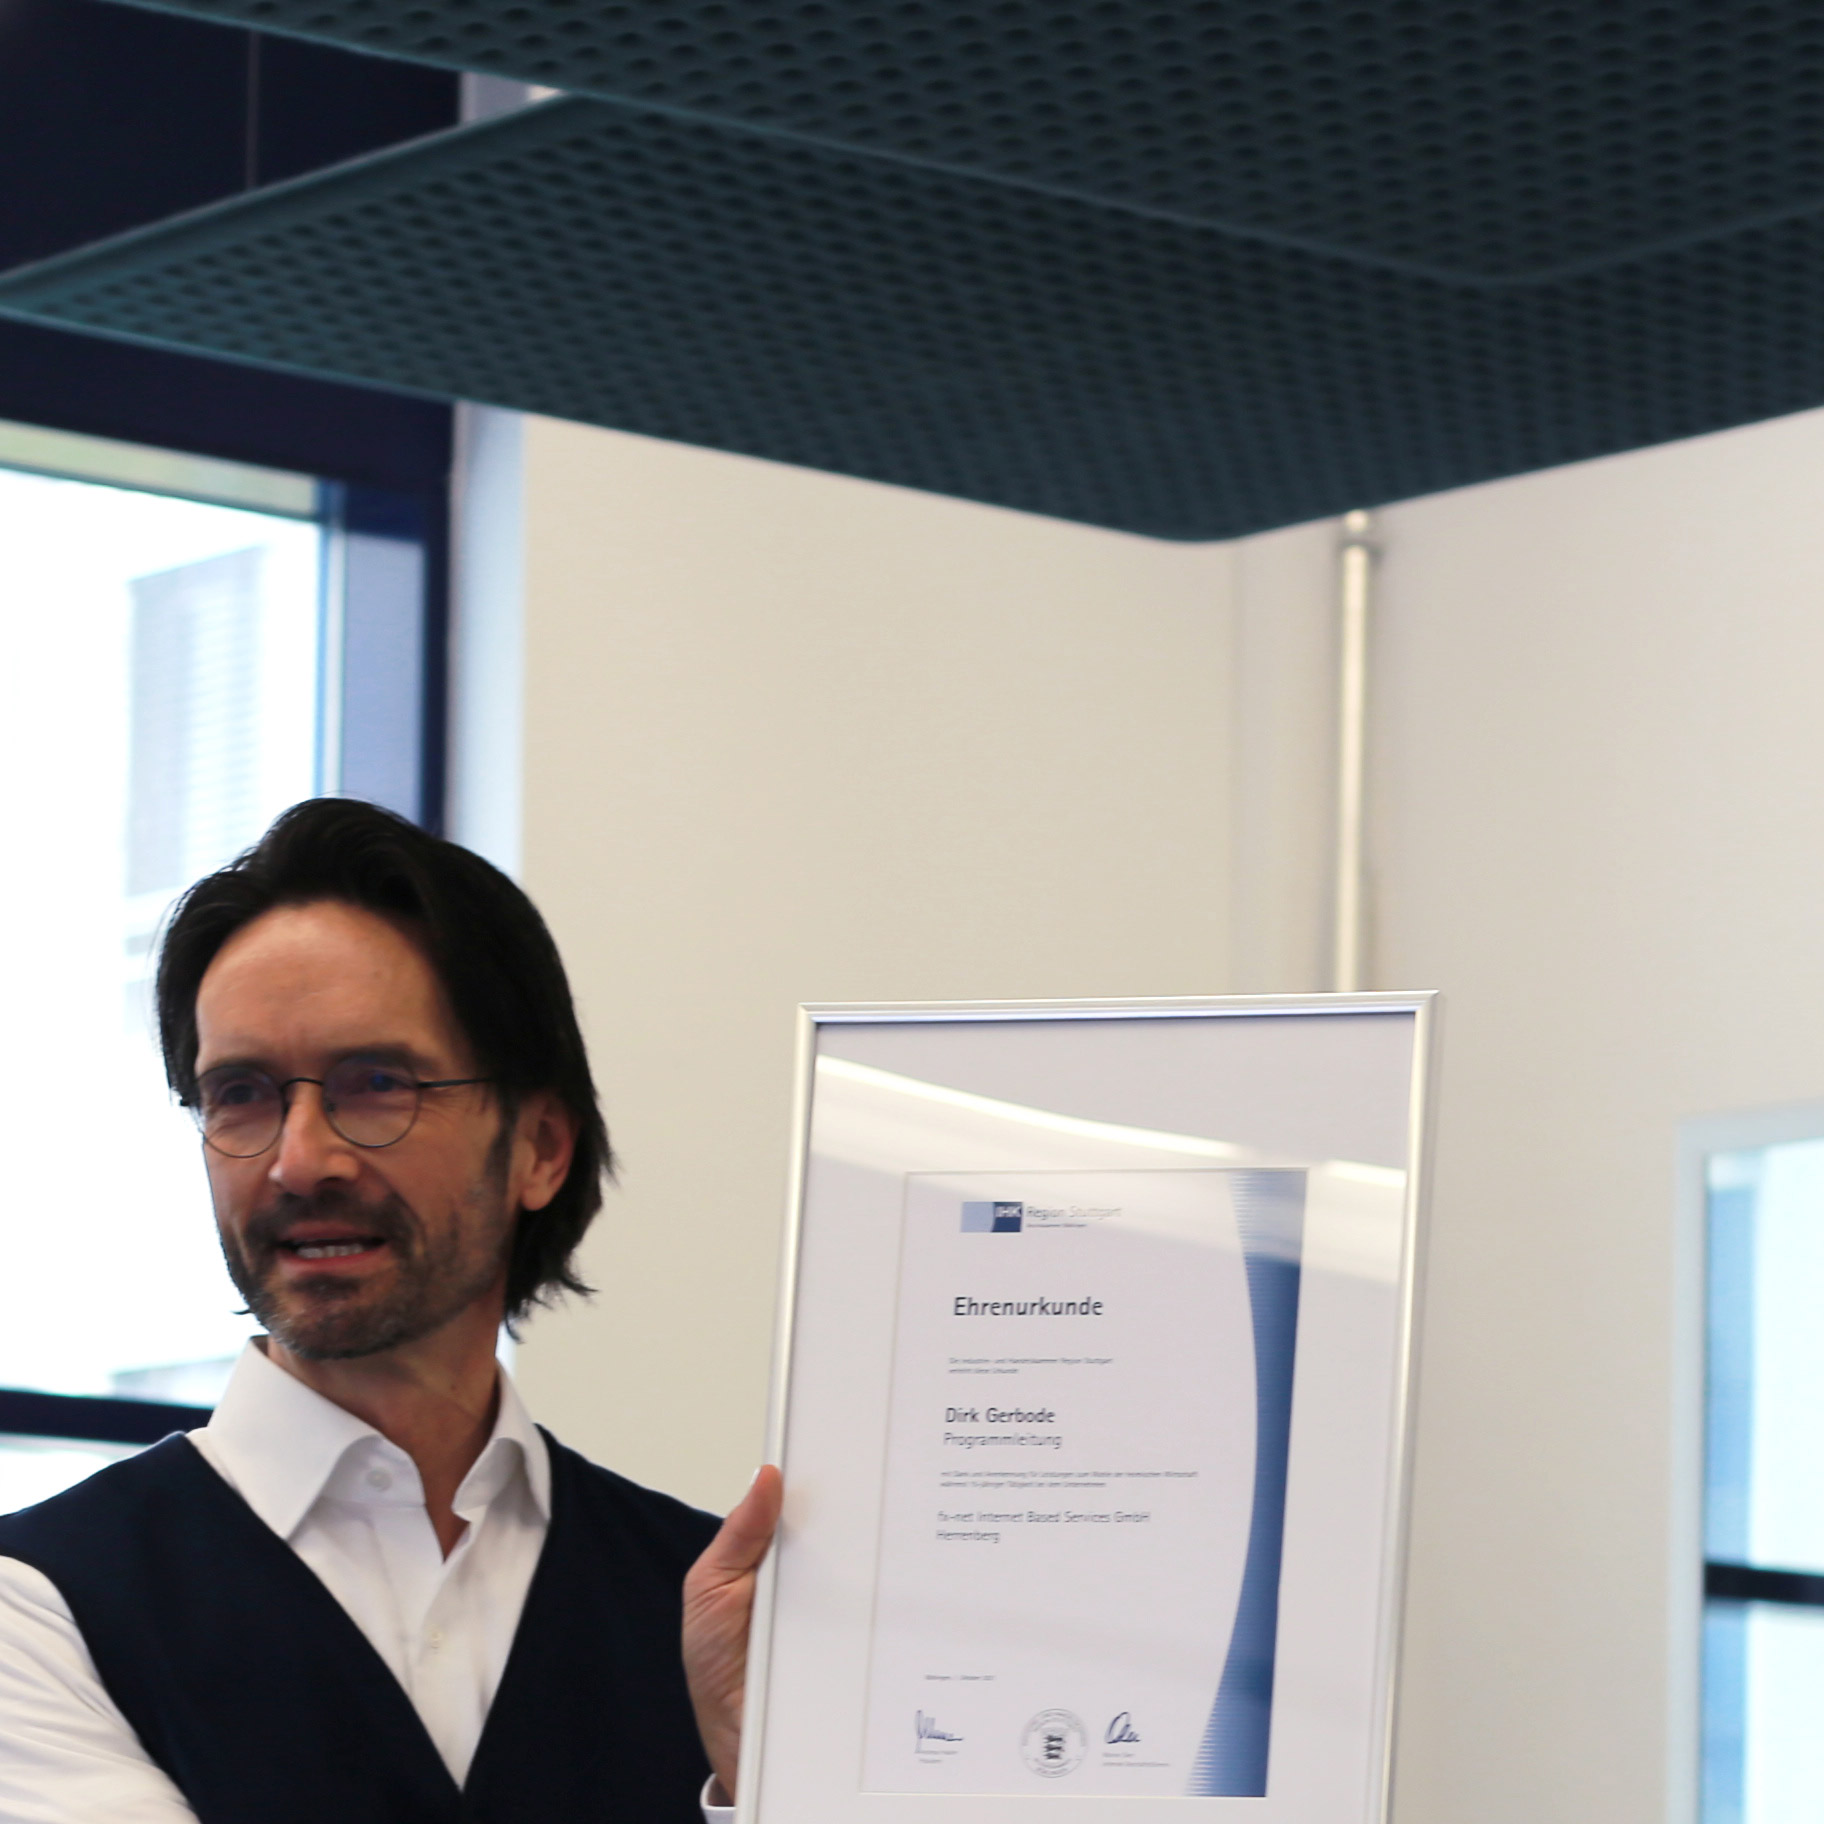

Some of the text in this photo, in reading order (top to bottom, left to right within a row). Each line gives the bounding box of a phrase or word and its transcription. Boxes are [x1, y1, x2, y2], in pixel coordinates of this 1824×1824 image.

[995, 1206, 1023, 1218] IHK
[1027, 1206, 1064, 1220] Region
[953, 1296, 1104, 1316] Ehrenurkunde
[945, 1407, 1057, 1423] Dirk Gerbode
[943, 1432, 1063, 1449] Programmleitung
[977, 1511, 1024, 1523] Internet
[1027, 1511, 1060, 1523] Based
[1063, 1511, 1111, 1523] Services
[1113, 1511, 1151, 1523] GmbH
